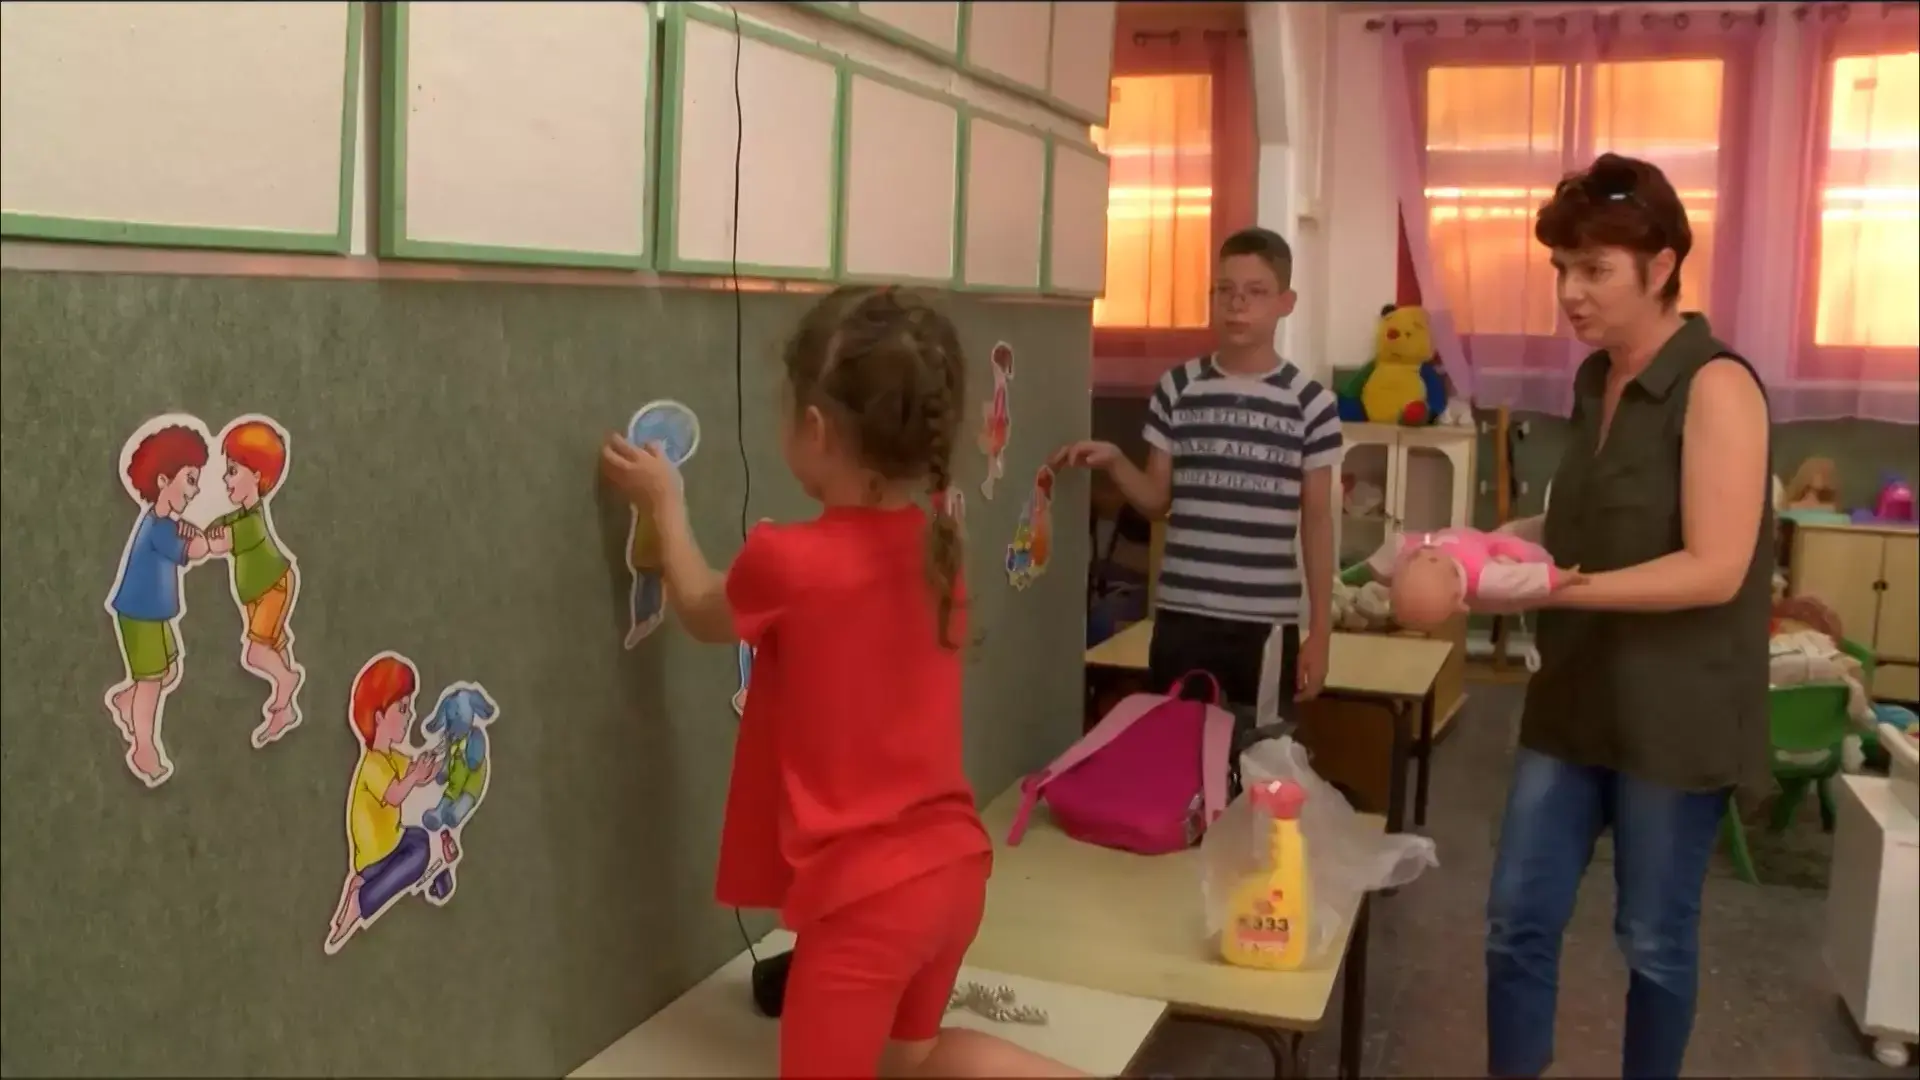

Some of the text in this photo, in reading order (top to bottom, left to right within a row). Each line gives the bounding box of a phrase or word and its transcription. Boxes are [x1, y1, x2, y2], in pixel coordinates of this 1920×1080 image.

[1178, 409, 1297, 433] ONE STEP CAN
[1222, 442, 1258, 458] ALL
[1179, 471, 1285, 492] DIFFERENCE
